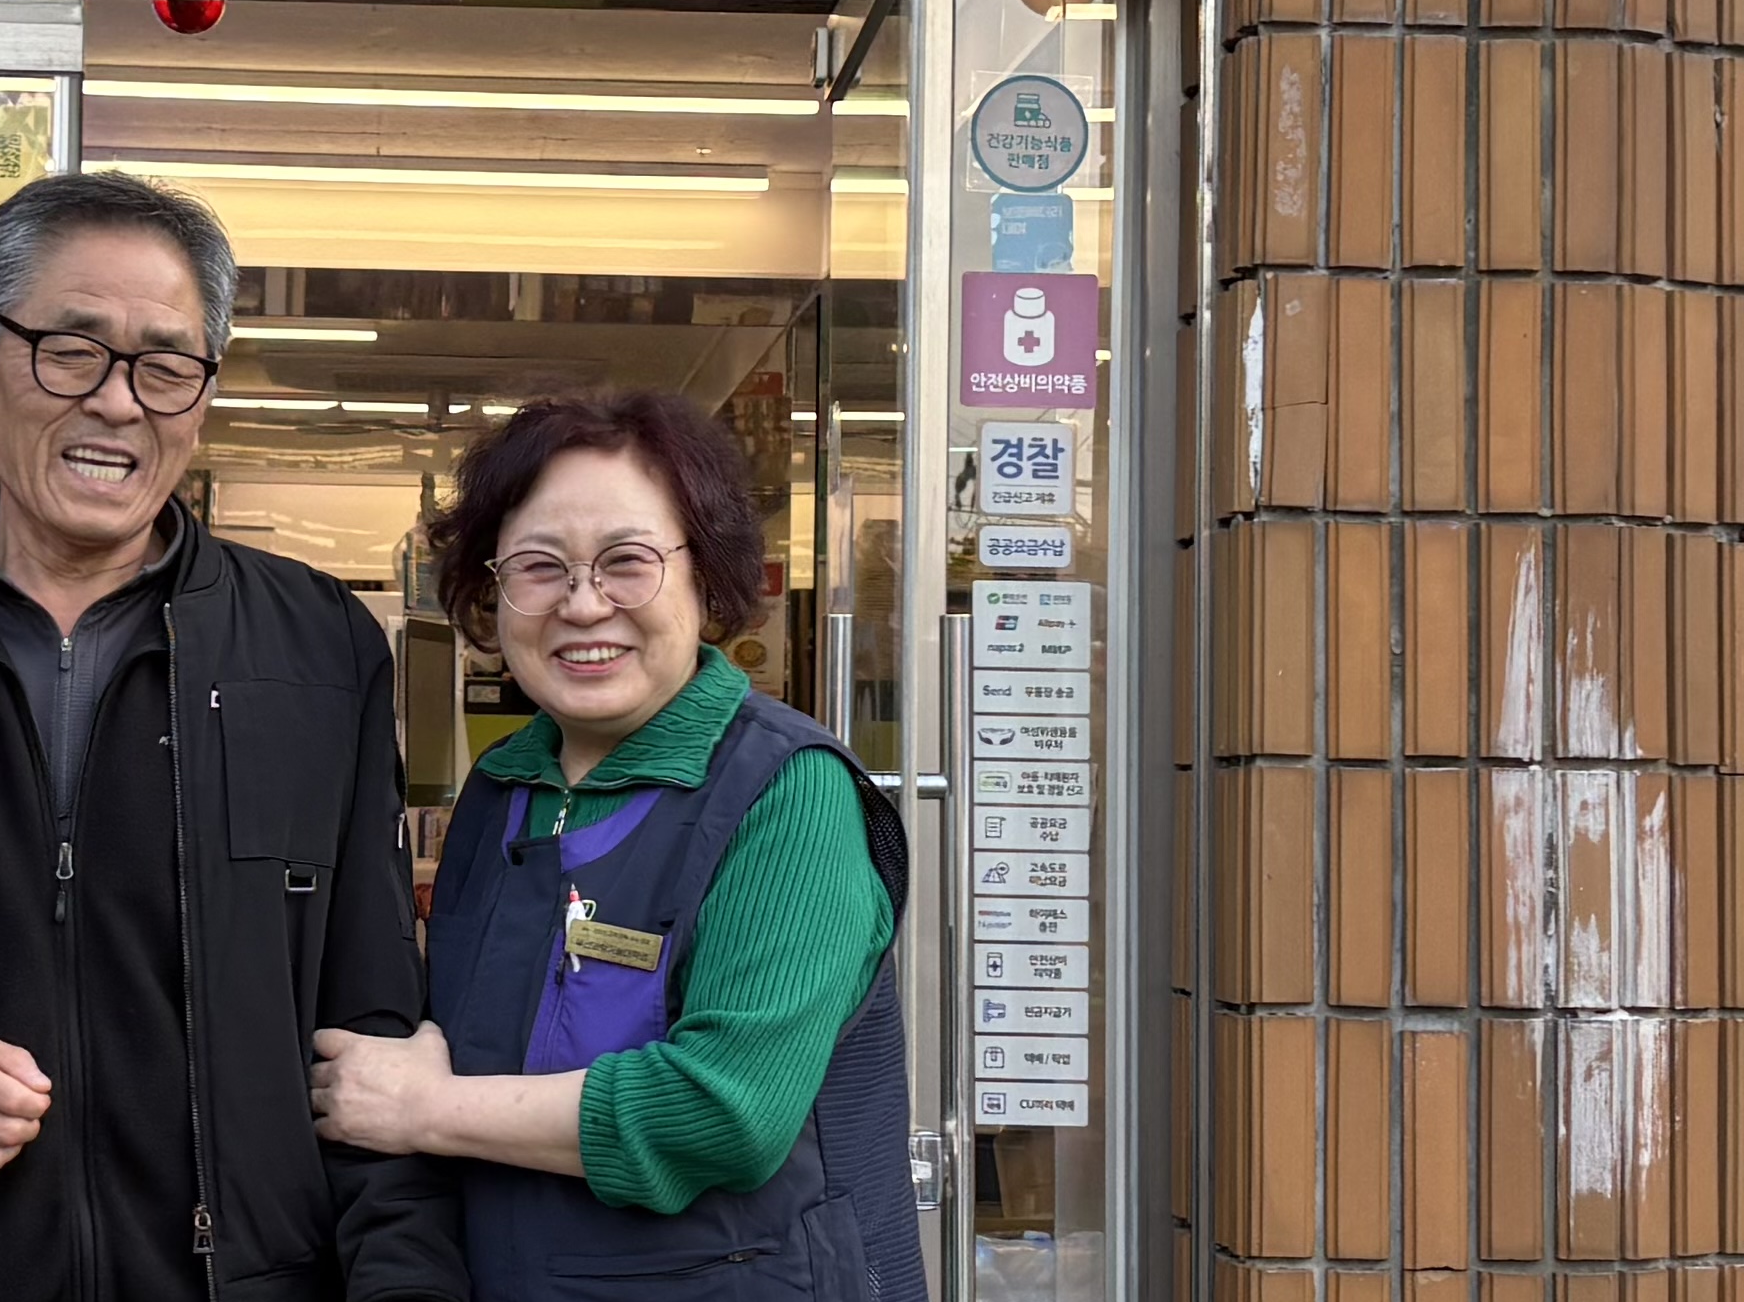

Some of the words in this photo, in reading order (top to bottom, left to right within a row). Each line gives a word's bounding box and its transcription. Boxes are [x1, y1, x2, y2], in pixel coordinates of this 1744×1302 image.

[987, 132, 1072, 152] 건강기능식품
[1007, 153, 1049, 170] 판매점
[970, 372, 1087, 394] 안전상비의약품
[990, 437, 1065, 480] 경찰
[992, 491, 1033, 503] 긴급신고
[987, 538, 1065, 557] 공공요금수납
[982, 685, 1012, 696] Send
[1066, 785, 1084, 796] 신고
[1029, 817, 1067, 829] 공공요금
